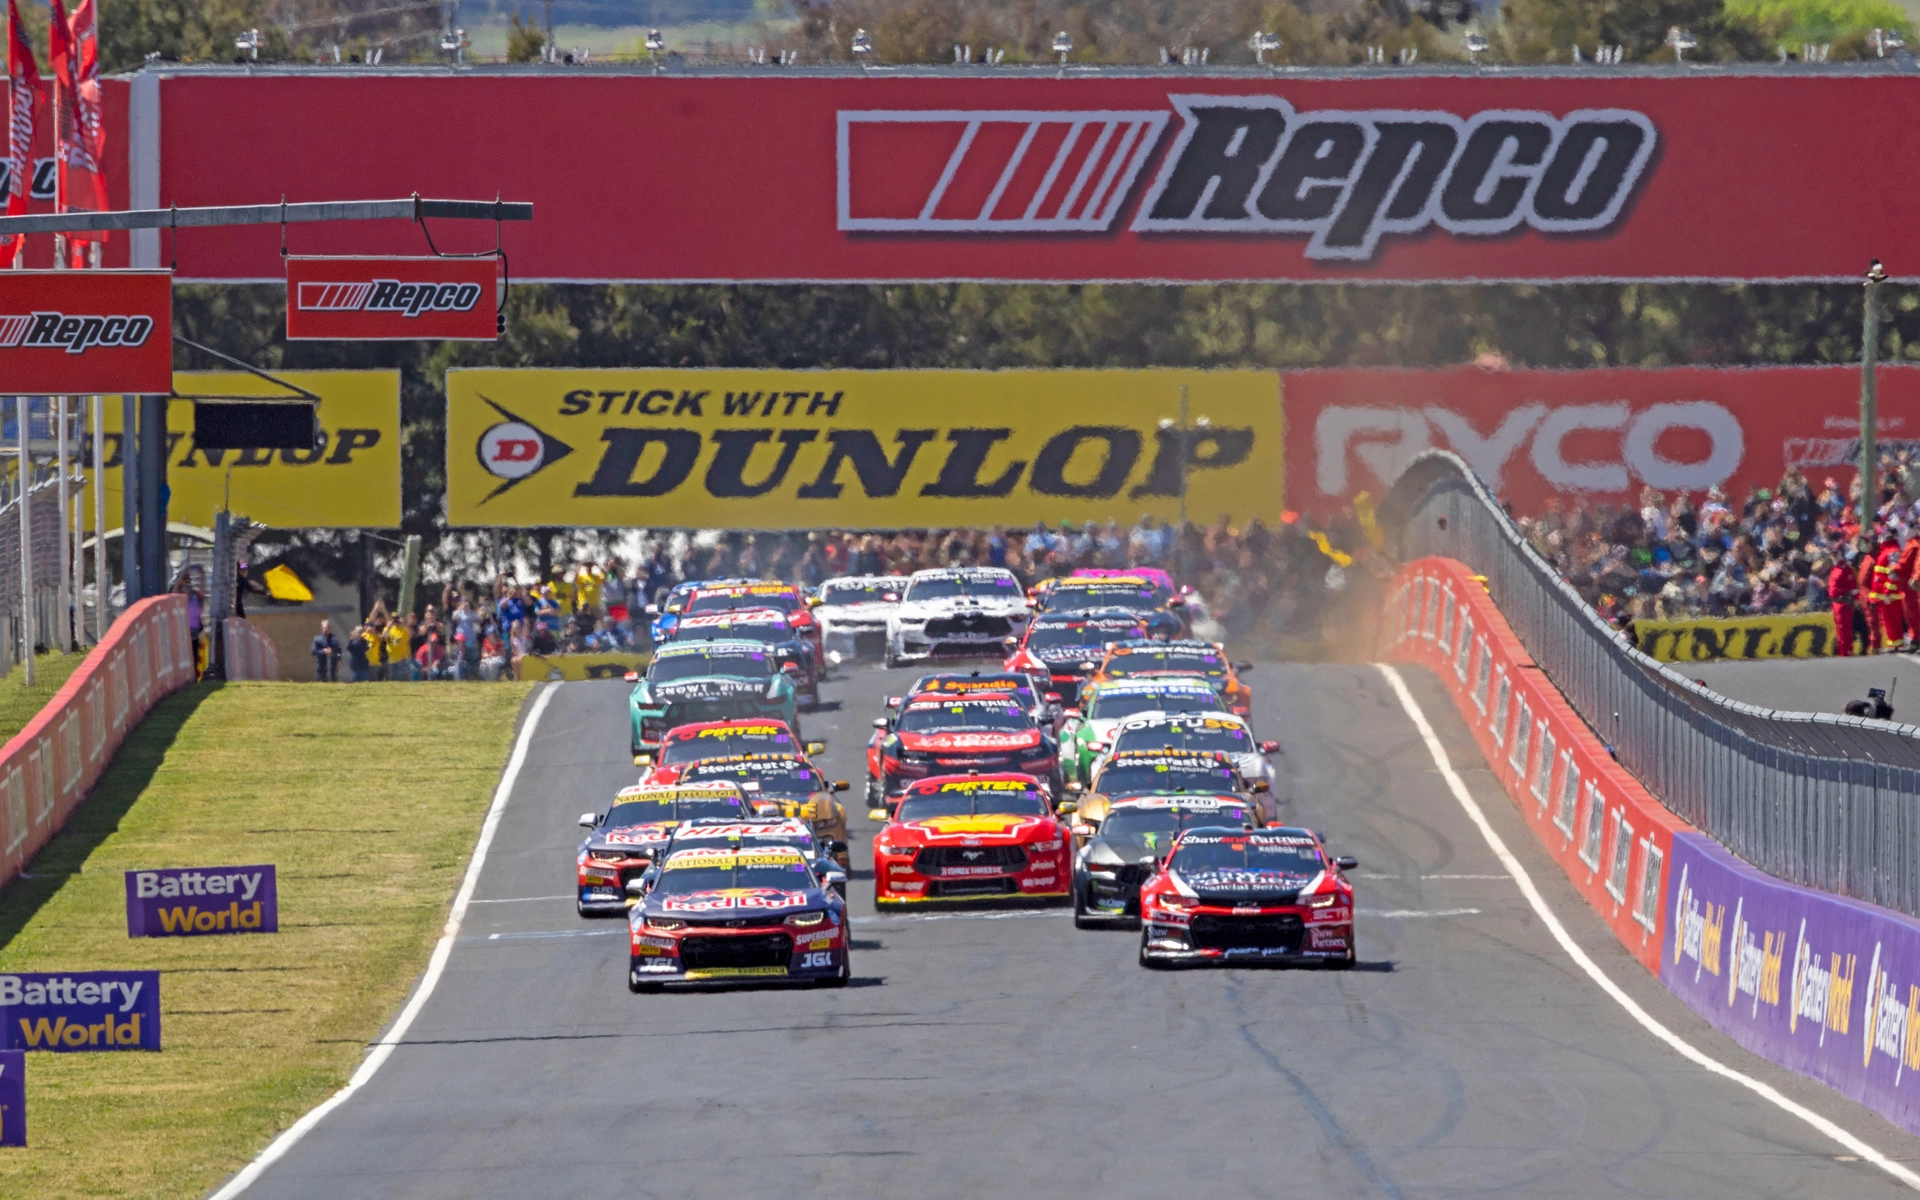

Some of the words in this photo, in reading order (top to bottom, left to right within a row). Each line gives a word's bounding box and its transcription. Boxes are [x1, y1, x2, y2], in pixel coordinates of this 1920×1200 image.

[1132, 94, 1657, 259] Repco
[368, 279, 481, 317] Repco
[22, 311, 153, 353] Repco
[559, 390, 709, 416] STICK
[722, 390, 843, 416] WITH
[1315, 401, 1745, 495] RYCO
[573, 426, 1256, 499] DUNLOP
[944, 680, 1018, 690] Scandia
[698, 726, 778, 738] PIRTEK
[698, 762, 779, 774] Steadfast
[1116, 757, 1198, 767] Steadfast
[941, 781, 1027, 792] PIRTEK
[616, 792, 672, 802] NATIONAL
[678, 789, 736, 797] STORAGE
[606, 833, 669, 845] Red
[681, 825, 797, 837] HIFLEX
[1181, 835, 1220, 844] Shaw
[1249, 835, 1315, 845] Partners
[668, 857, 732, 867] NATIONAL
[136, 872, 262, 900] Battery
[663, 895, 735, 911] Red
[738, 894, 807, 909] Bull
[158, 902, 261, 932] World
[633, 934, 676, 949] SUPERCHEAP
[796, 927, 840, 945] SUPERCHEAP
[0, 975, 142, 1012] Battery
[19, 1013, 140, 1046] World
